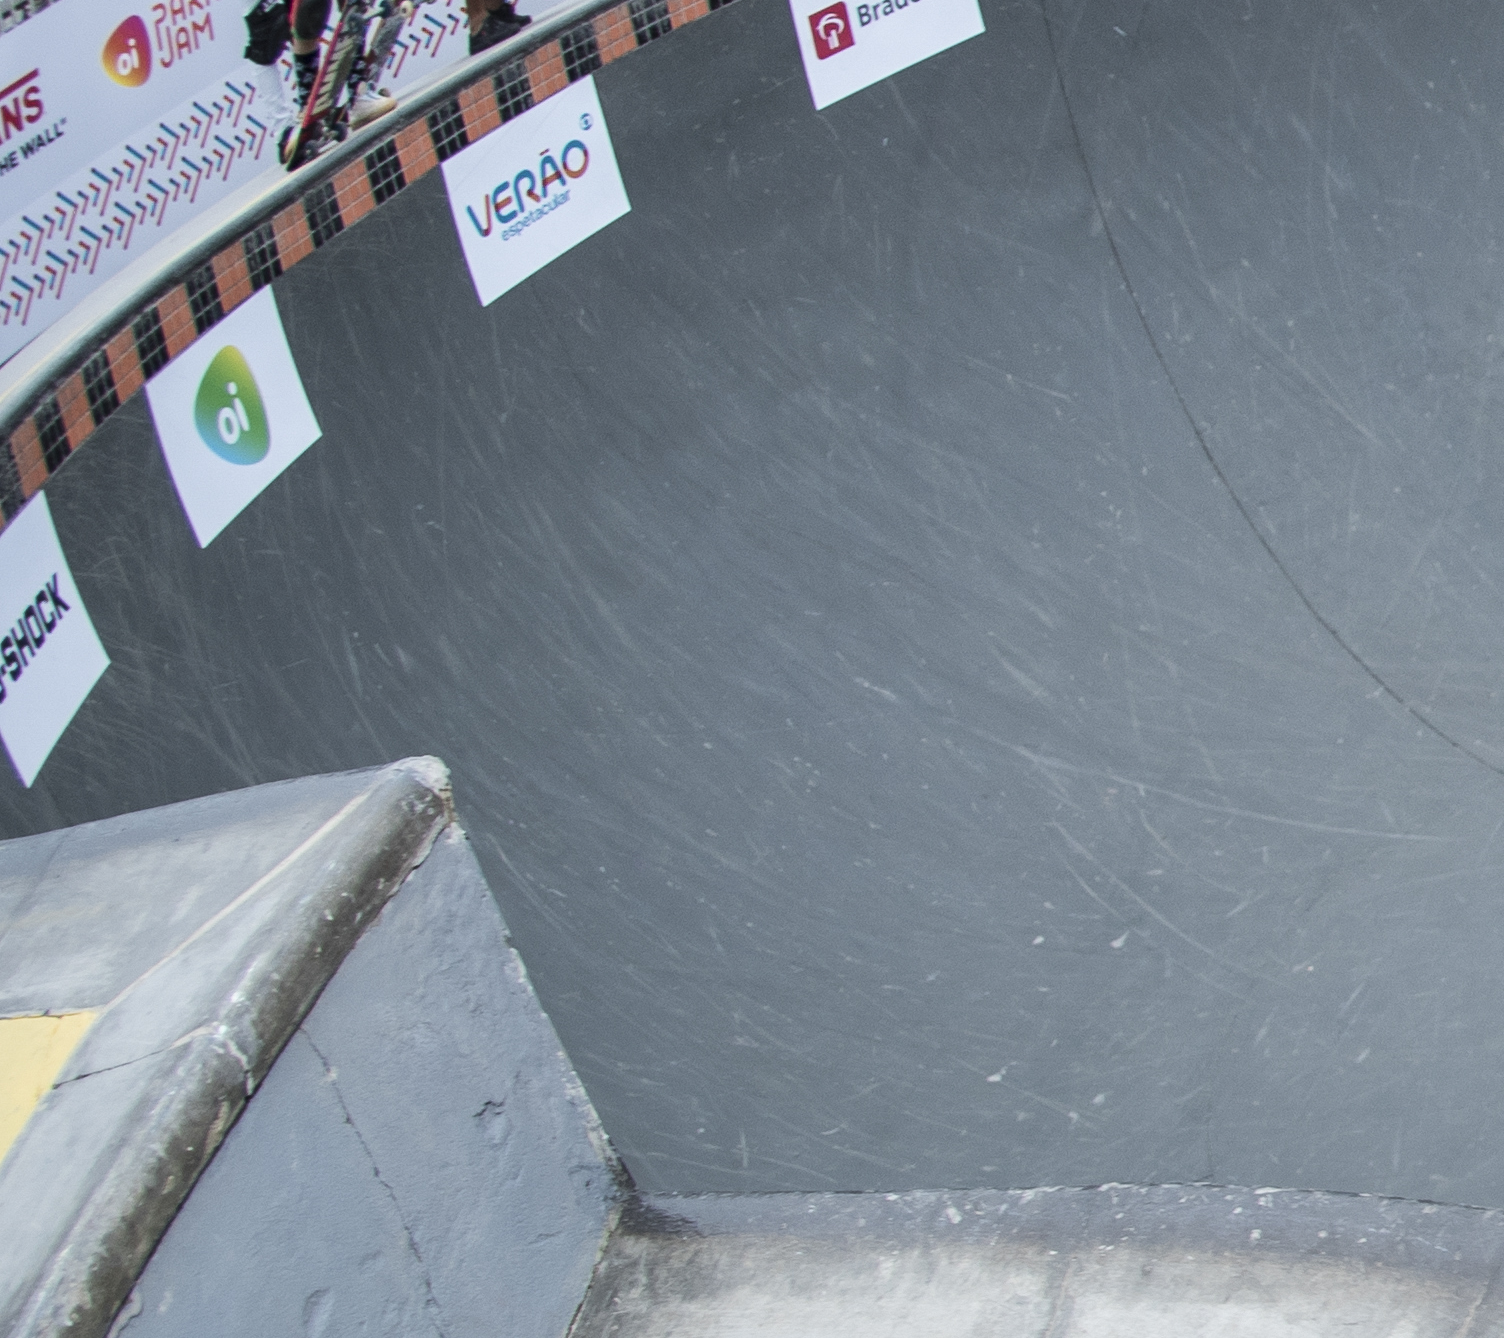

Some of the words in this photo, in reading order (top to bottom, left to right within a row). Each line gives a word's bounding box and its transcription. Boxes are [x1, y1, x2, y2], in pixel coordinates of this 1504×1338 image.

[116, 38, 140, 77] oi
[160, 11, 215, 69] JAM
[466, 139, 590, 238] VERÃO
[216, 381, 250, 445] oi
